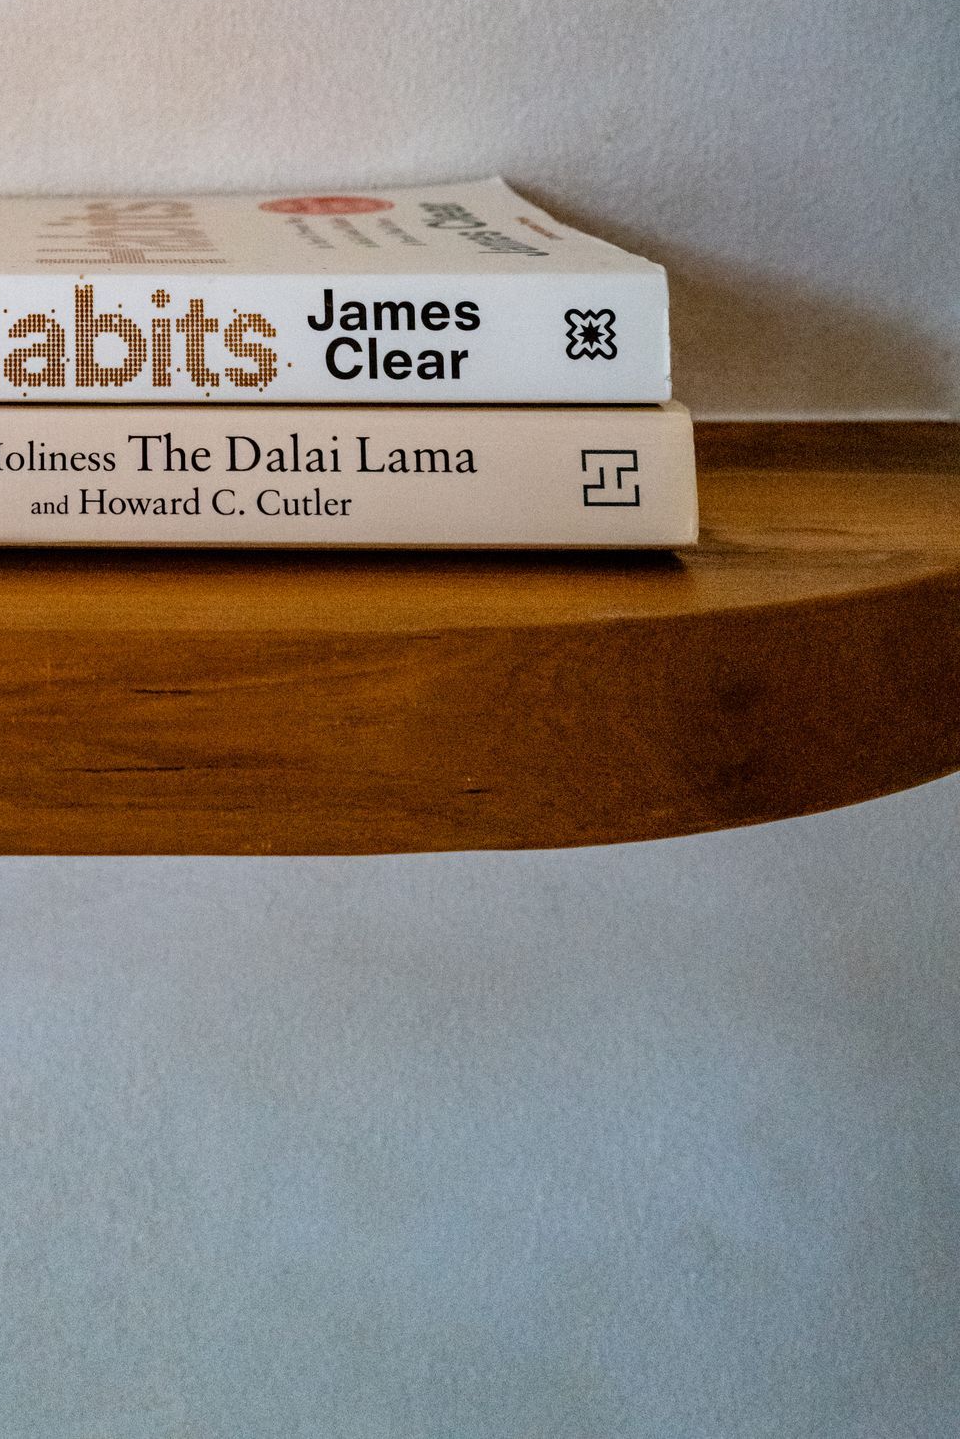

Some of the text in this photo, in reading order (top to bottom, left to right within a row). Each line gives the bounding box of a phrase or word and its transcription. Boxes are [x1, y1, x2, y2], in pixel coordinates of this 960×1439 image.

[307, 288, 481, 332] James
[325, 336, 469, 381] Clear
[127, 432, 212, 473] The
[225, 432, 342, 473] Dalai
[355, 435, 478, 474] Lama
[30, 486, 353, 517] and Howard C. Cutler
